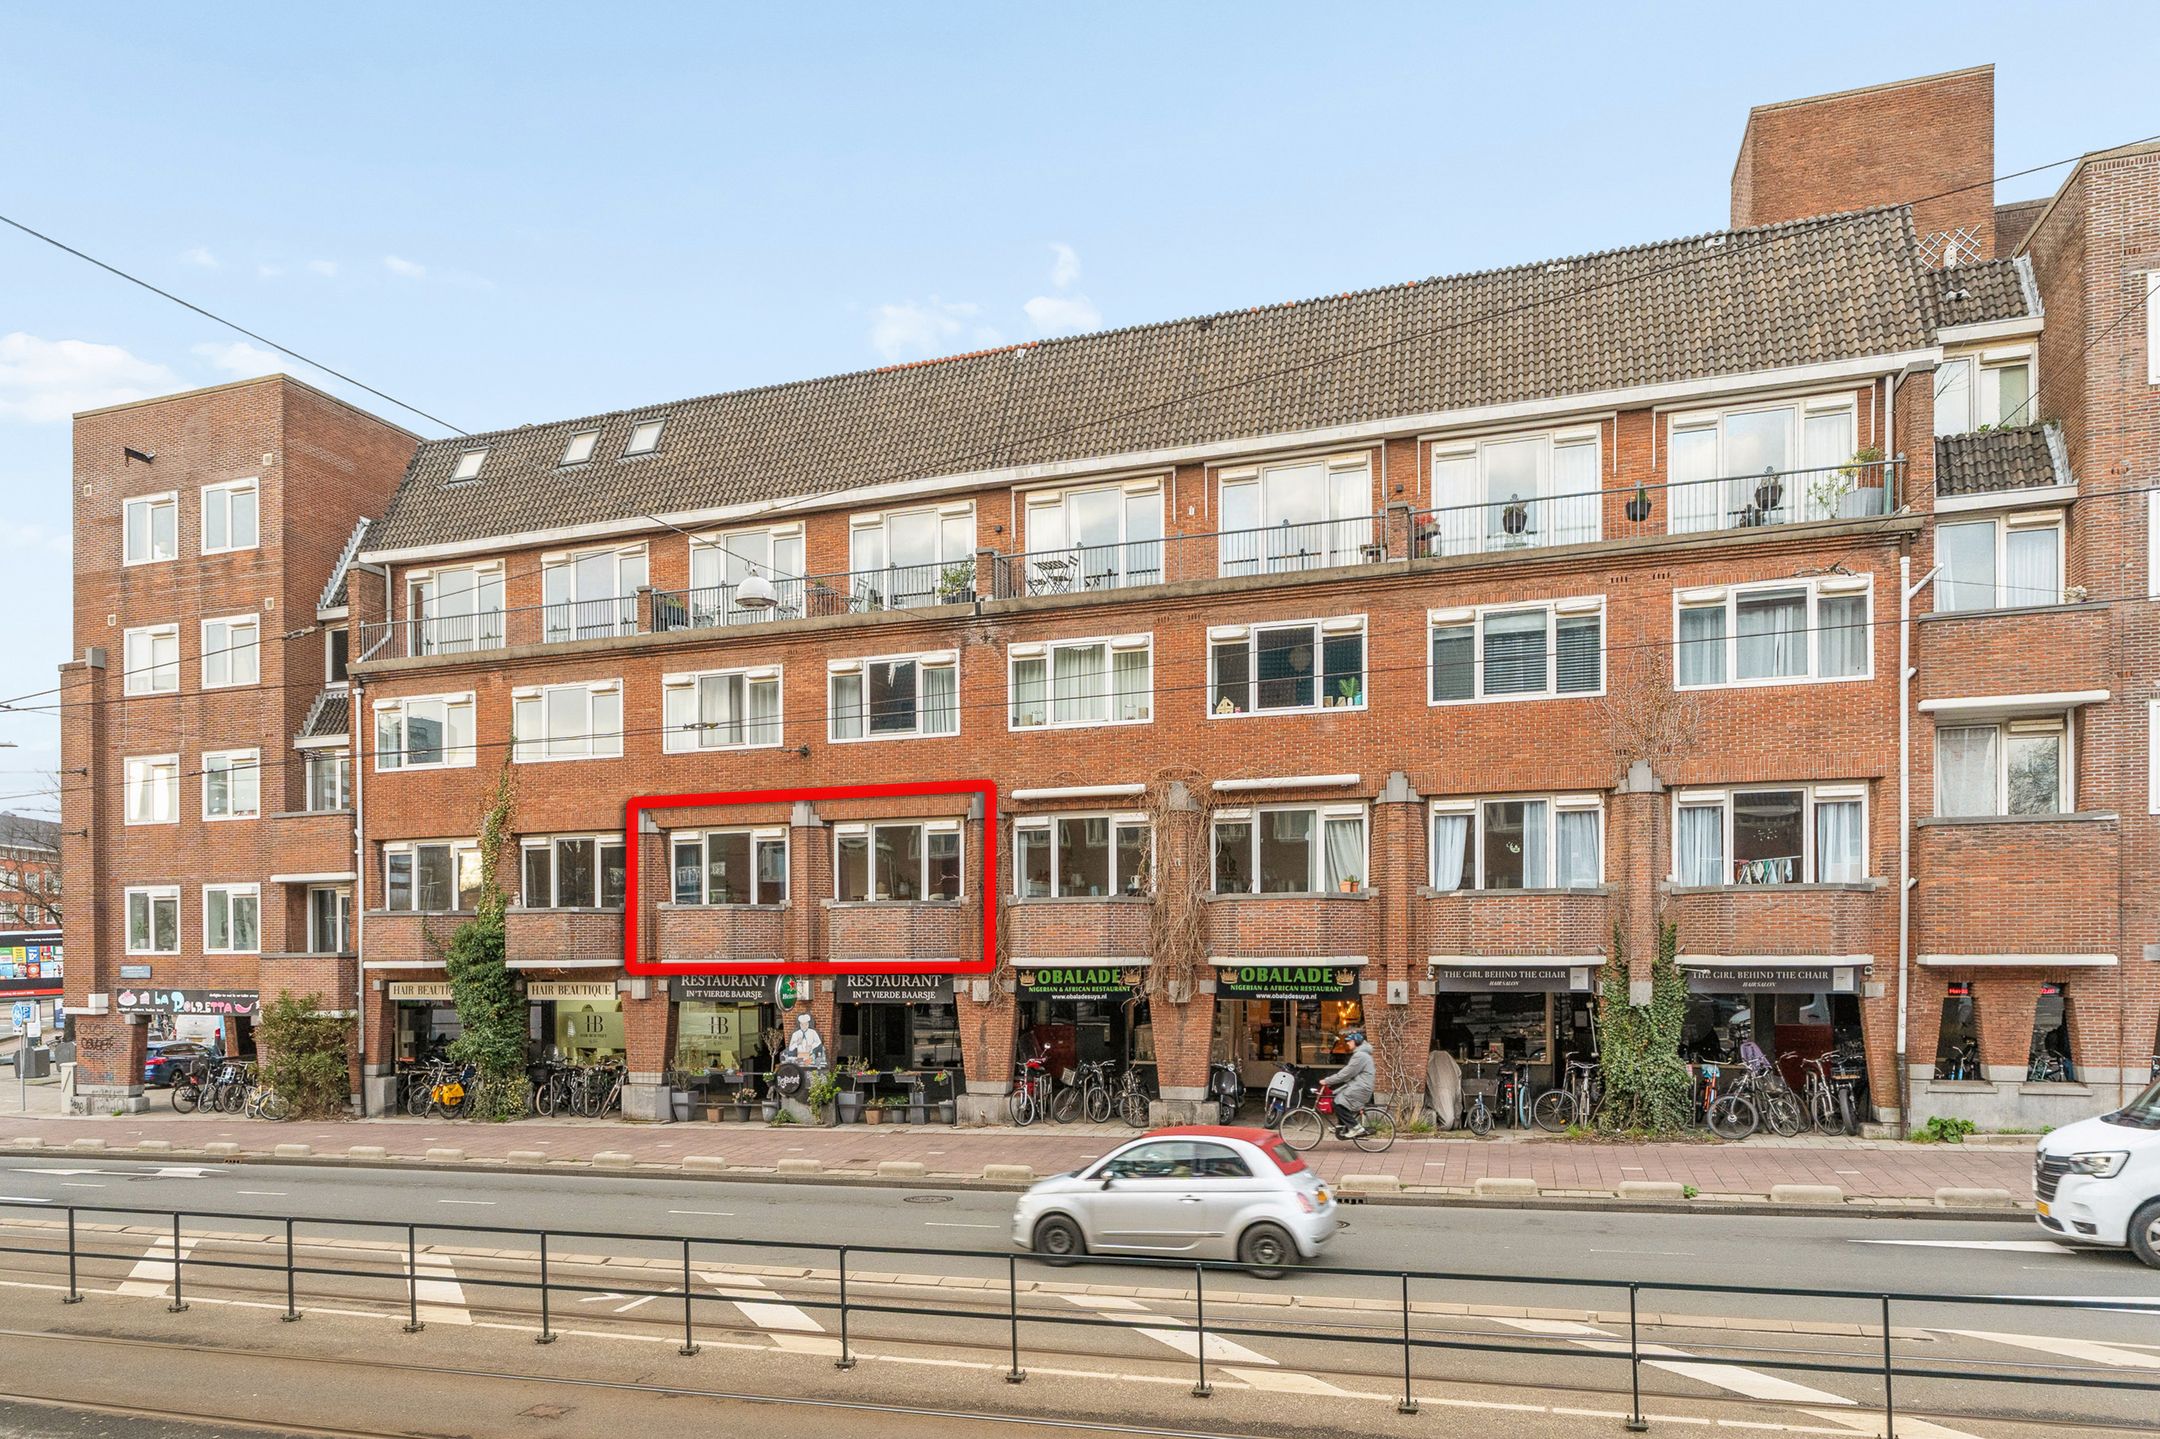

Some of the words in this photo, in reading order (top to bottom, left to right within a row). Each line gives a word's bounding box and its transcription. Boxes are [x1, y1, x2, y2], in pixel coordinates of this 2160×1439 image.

[1037, 969, 1121, 984] OBALADE
[1240, 967, 1333, 983] OBALADE
[1444, 970, 1461, 978] THE
[1463, 970, 1483, 978] GIRL
[1485, 970, 1517, 978] BEHIND
[1519, 970, 1537, 978] THE
[1539, 970, 1566, 979] CHAIR
[1693, 971, 1711, 979] THE
[1713, 971, 1735, 979] GIRL
[1737, 971, 1774, 979] BEHIND
[1776, 971, 1796, 979] THE
[1798, 971, 1829, 979] CHAIR
[681, 975, 768, 987] RESTAURANT
[847, 975, 942, 987] RESTAURANT
[394, 985, 414, 995] HAIR
[418, 985, 453, 995] BEAUTI
[532, 985, 554, 995] HAIR
[558, 985, 611, 997] BEAUTIQUE
[731, 991, 763, 1000] BAARSJE
[871, 991, 901, 999] VIERDE
[902, 991, 936, 1000] BAARSJE
